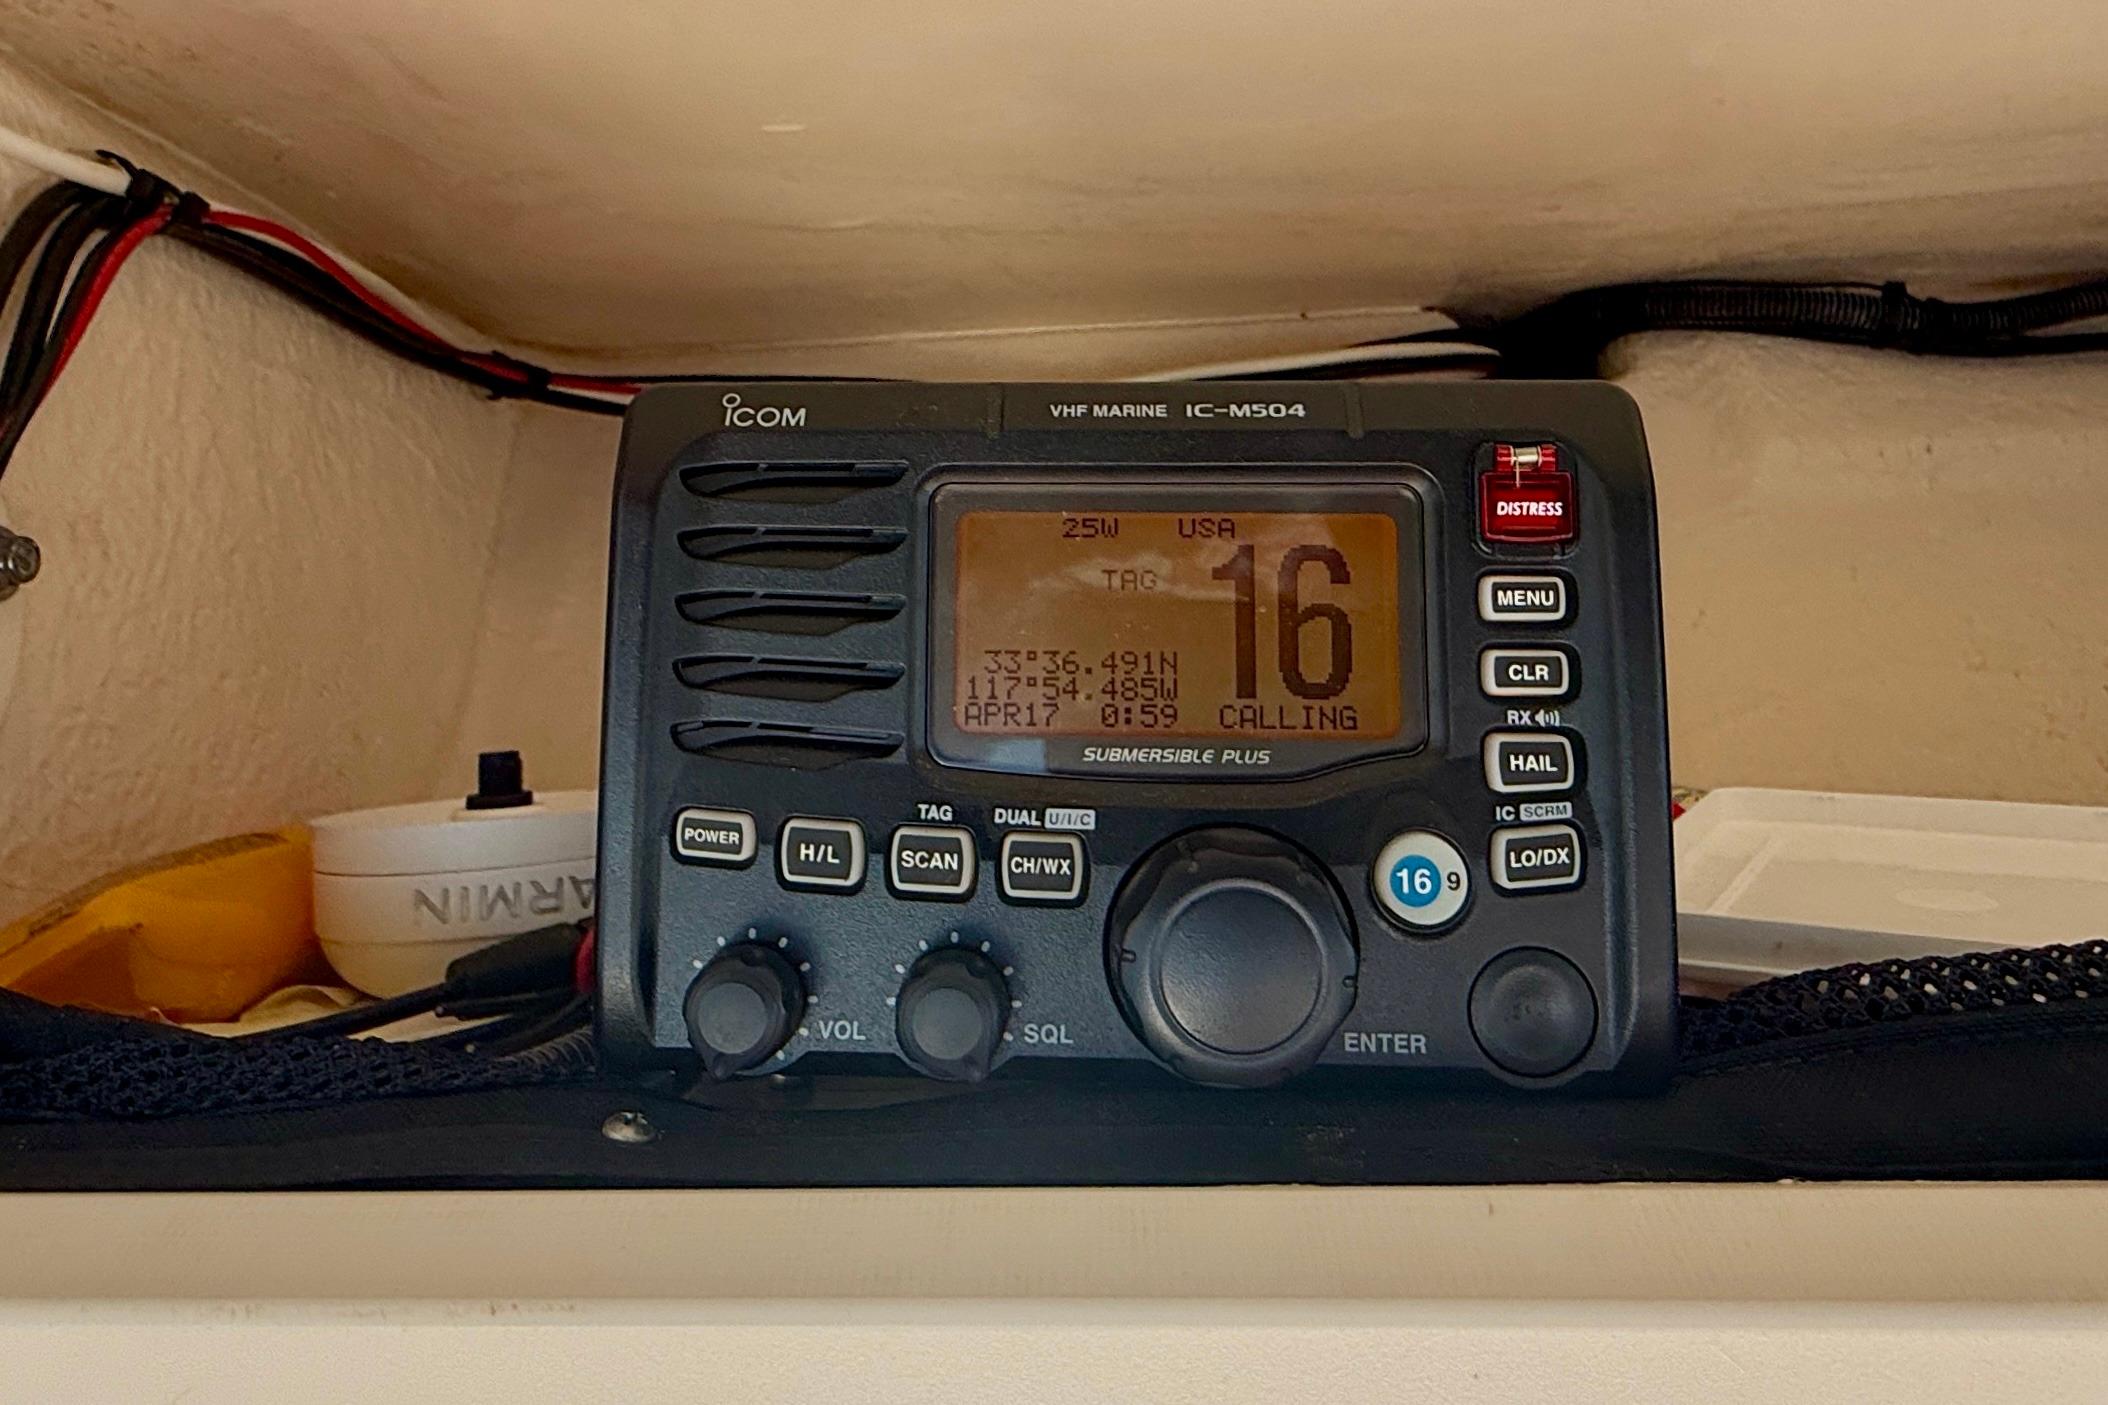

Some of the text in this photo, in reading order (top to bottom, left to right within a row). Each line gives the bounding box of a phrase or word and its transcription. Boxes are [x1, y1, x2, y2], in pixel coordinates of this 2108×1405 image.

[1050, 403, 1306, 418] VHF MARINE IC-M504
[1496, 501, 1563, 517] DISTRESS
[1062, 517, 1236, 539] 25W USA
[1101, 568, 1157, 591] TAG
[1497, 590, 1554, 607] MENU
[1211, 543, 1353, 700] 16
[1508, 664, 1549, 682] CLR
[964, 702, 1178, 728] APR17 0:59
[1219, 705, 1358, 731] CALLING
[1507, 710, 1531, 725] RX
[1082, 746, 1271, 765] SUBMERSIBLE PLUS
[1509, 755, 1558, 773] HAIL
[917, 803, 953, 821] TAG
[994, 809, 1092, 828] DUAL U/I/C
[1496, 804, 1568, 821] IC SCRM
[684, 827, 740, 846] POWER
[800, 843, 840, 864] H/L
[900, 850, 959, 871] SCAN
[1509, 847, 1571, 869] LO/DX
[1010, 856, 1072, 876] CH/WX
[1395, 867, 1461, 895] 16 9
[412, 874, 596, 926] ARMIN
[818, 1020, 867, 1041] VOL
[1024, 1023, 1074, 1045] SQL
[1344, 1032, 1427, 1054] ENTER
